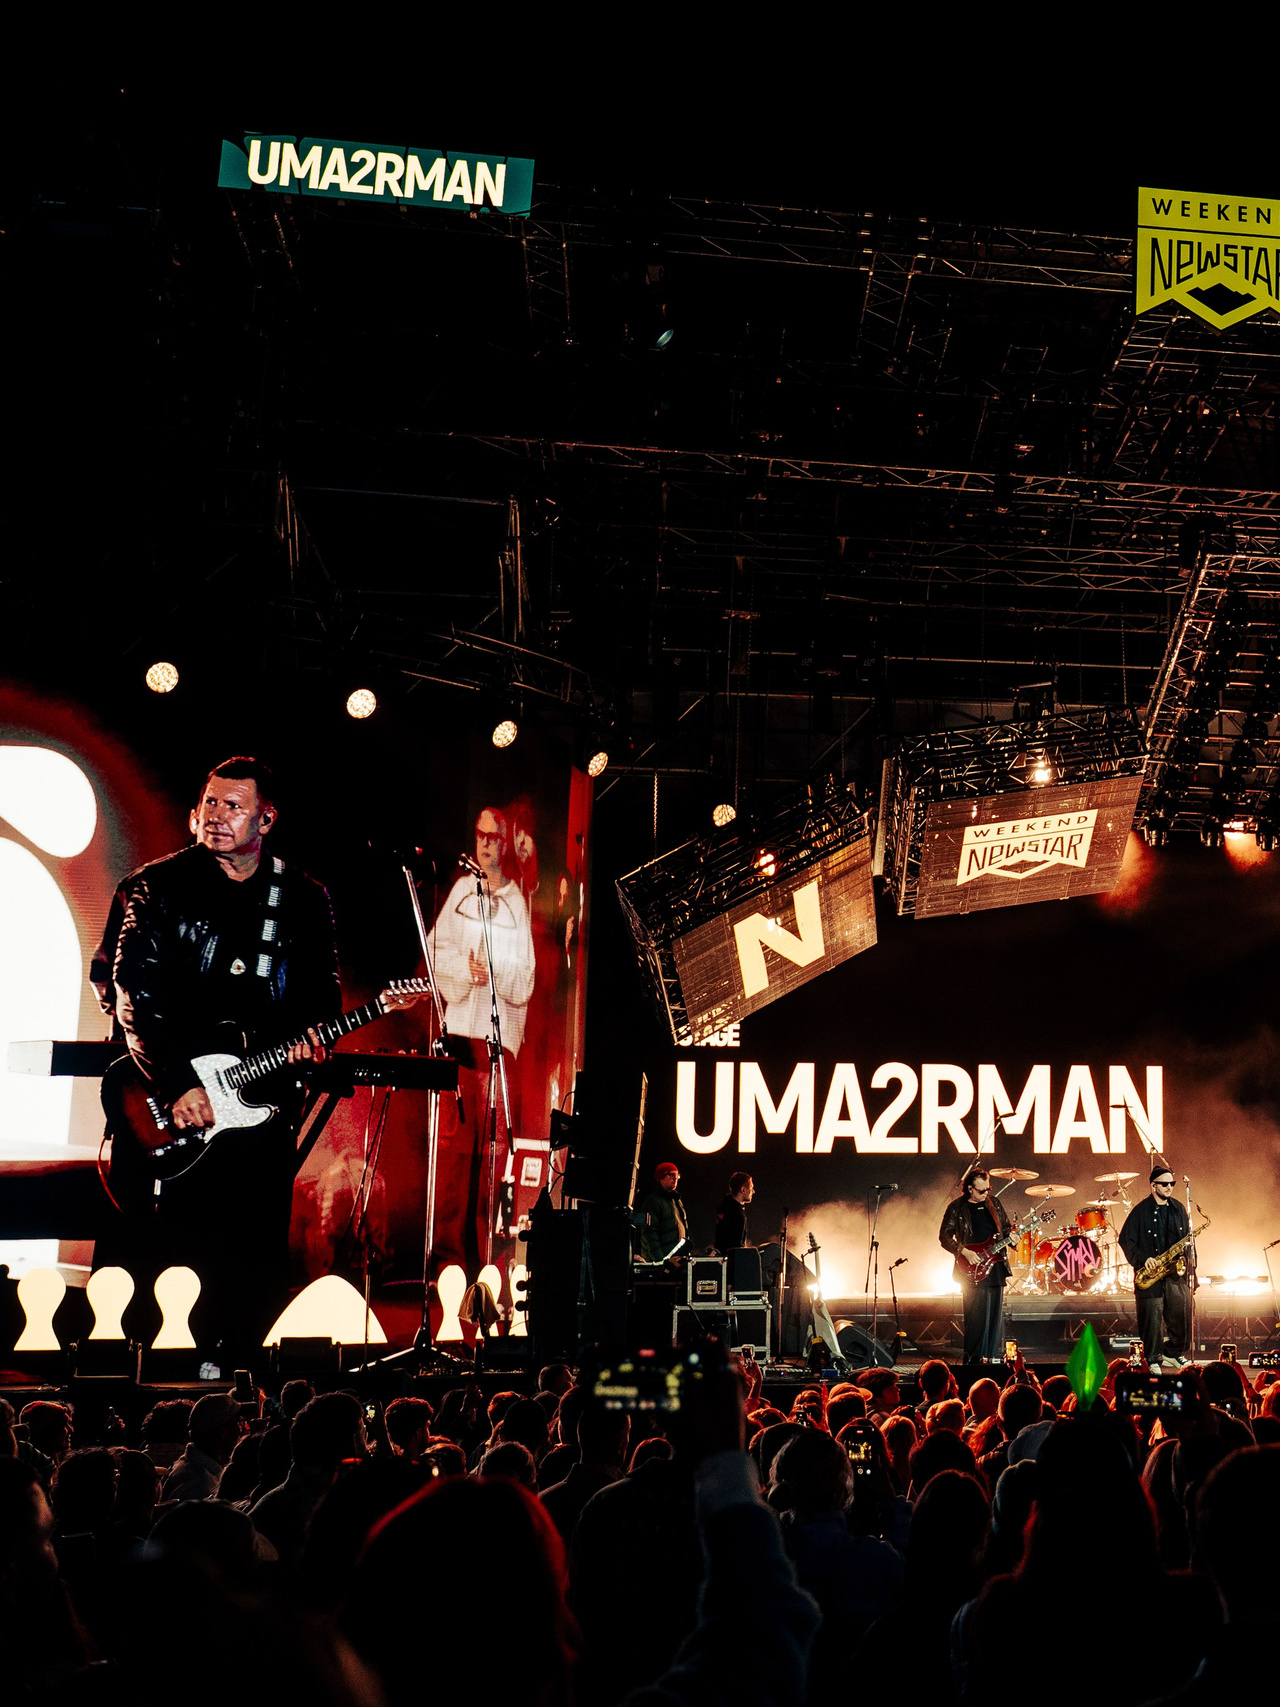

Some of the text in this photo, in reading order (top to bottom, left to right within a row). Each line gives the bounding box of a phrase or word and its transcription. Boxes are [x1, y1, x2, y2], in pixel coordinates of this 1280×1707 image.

[248, 140, 507, 207] UMA2RMAN
[973, 815, 1089, 838] WEEKEND
[733, 879, 825, 999] N
[675, 1061, 1164, 1154] UMA2RMAN
